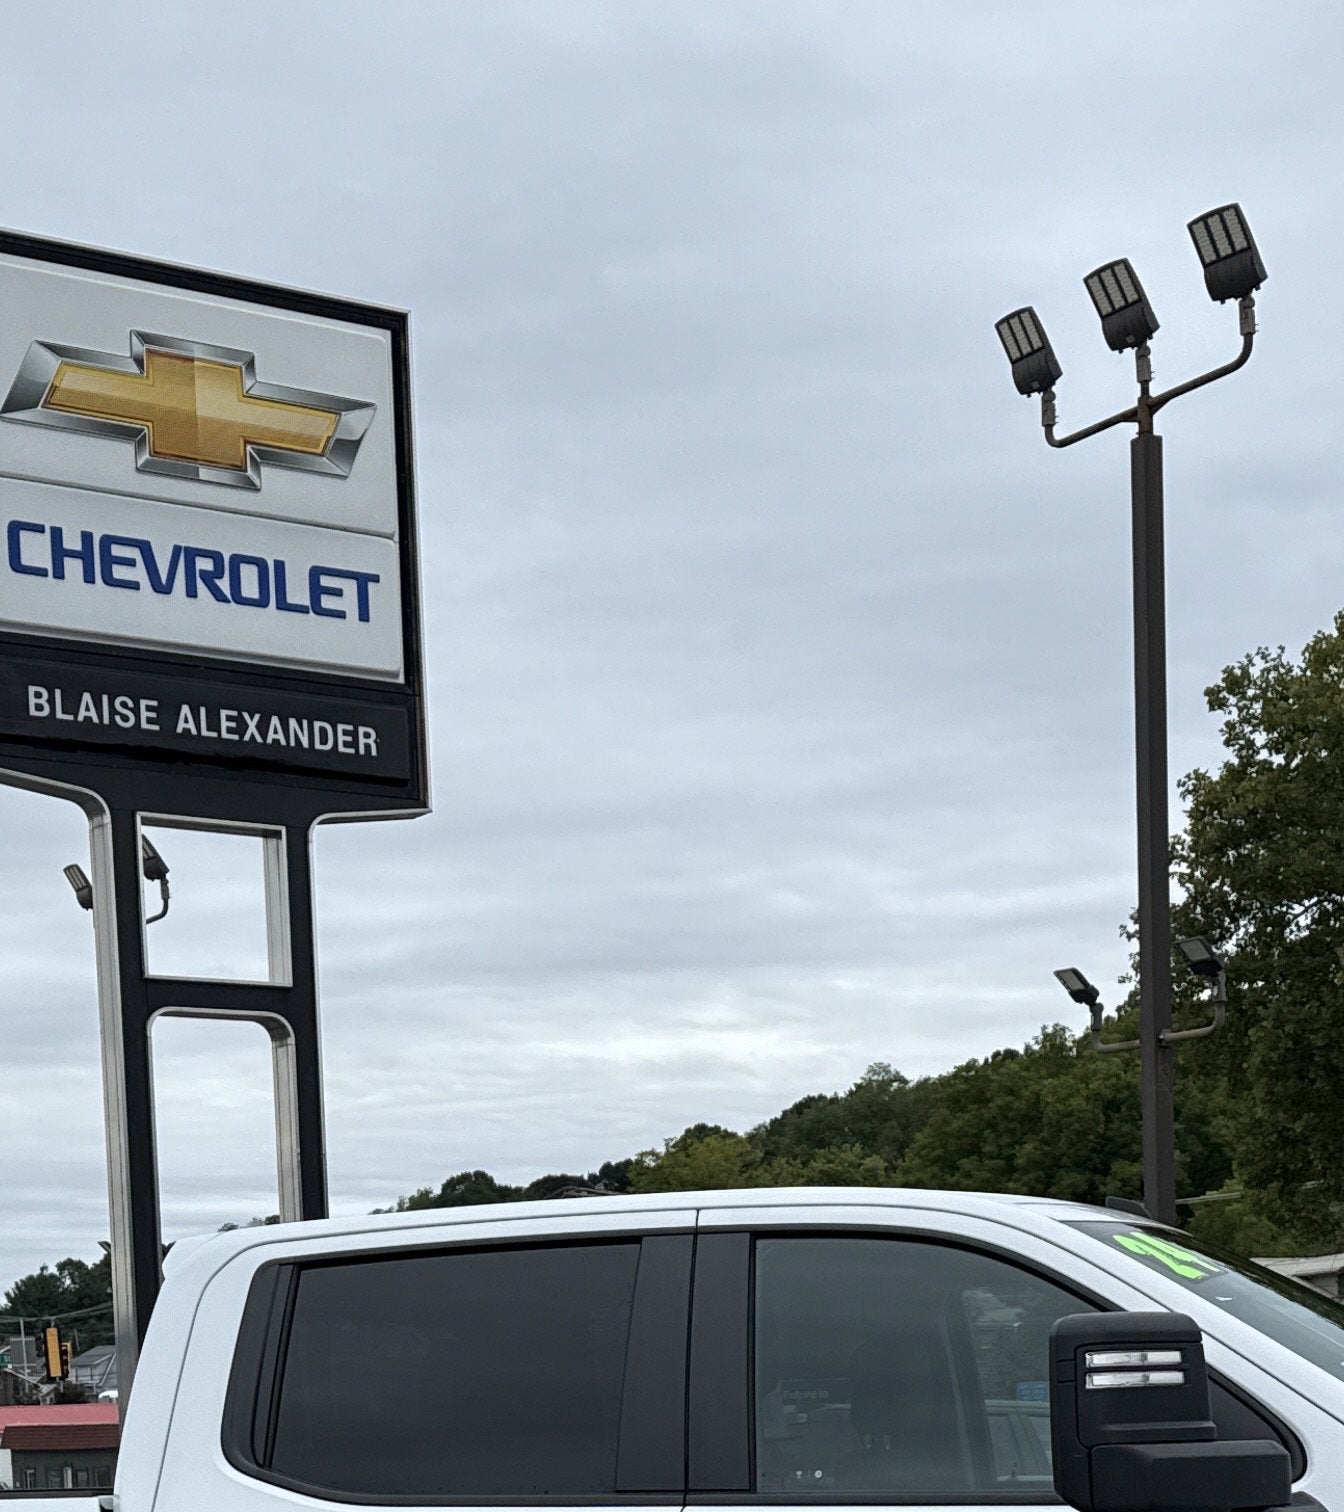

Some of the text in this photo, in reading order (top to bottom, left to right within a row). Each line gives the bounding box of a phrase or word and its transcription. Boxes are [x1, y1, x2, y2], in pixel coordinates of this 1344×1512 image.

[7, 520, 380, 622] CHEVROLET
[28, 684, 378, 757] BLAISE ALEXANDER
